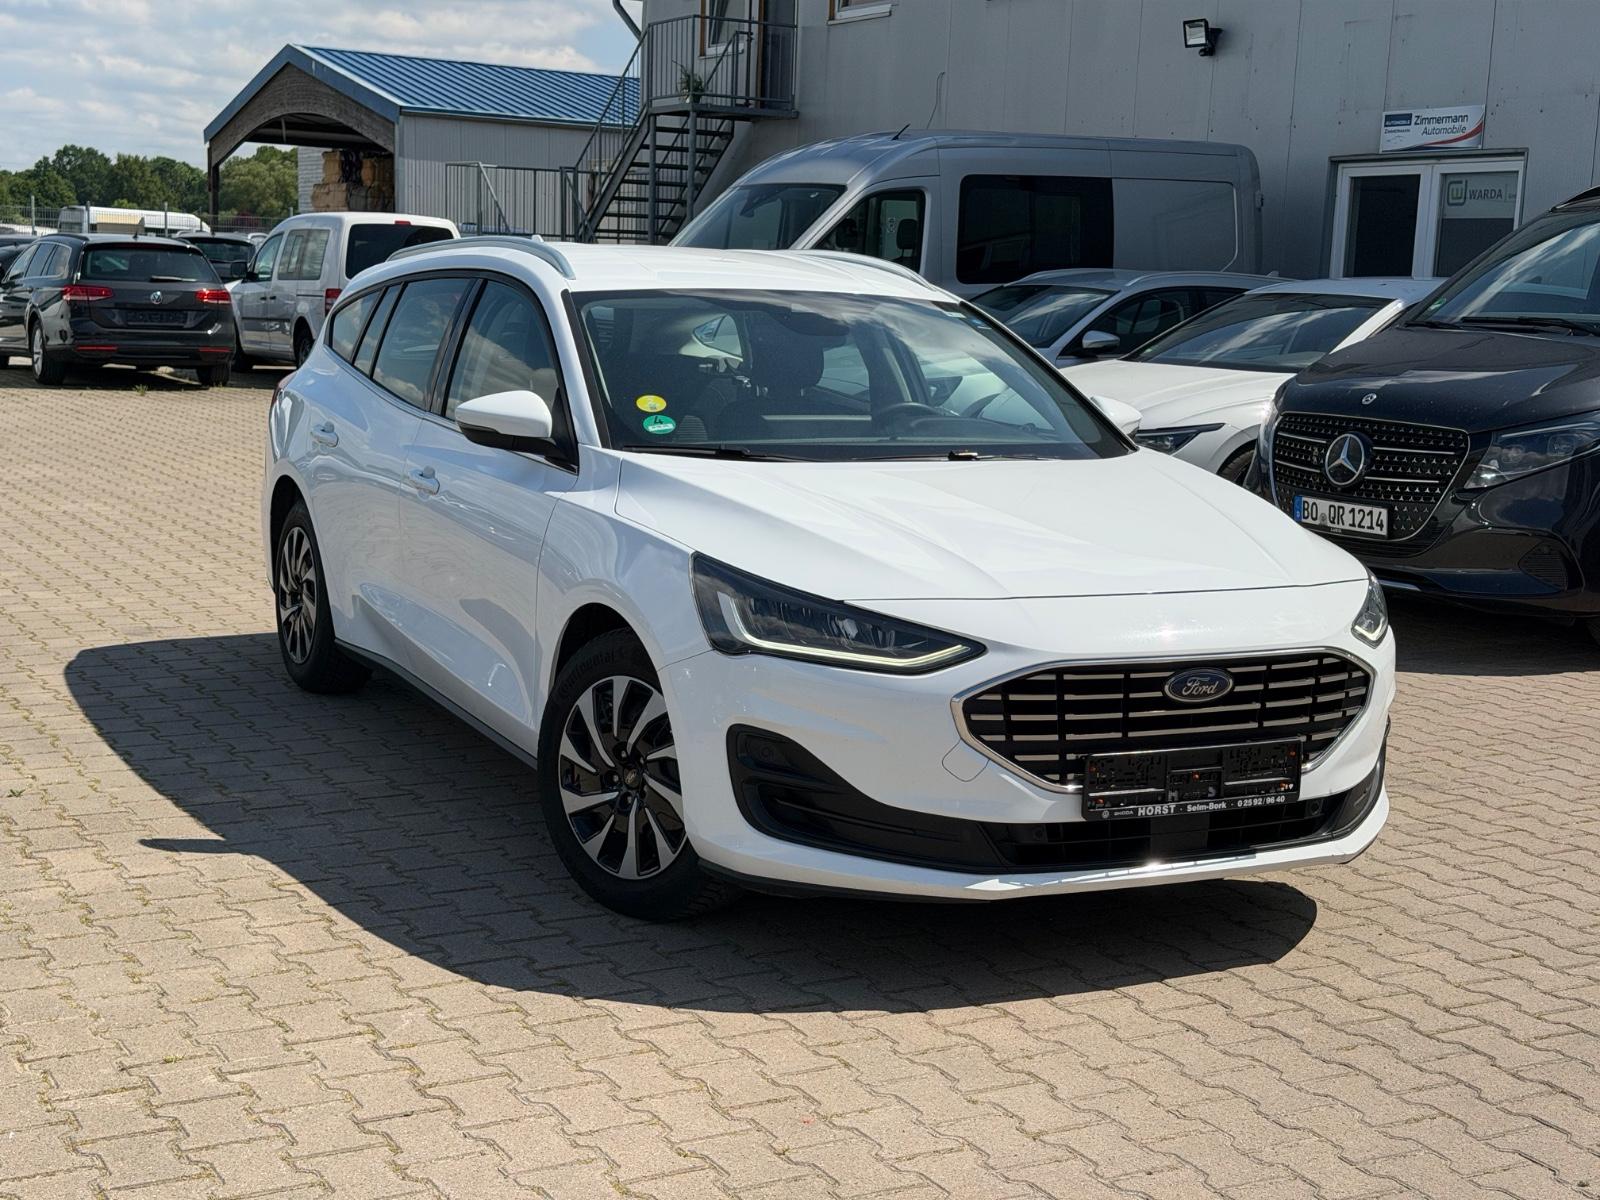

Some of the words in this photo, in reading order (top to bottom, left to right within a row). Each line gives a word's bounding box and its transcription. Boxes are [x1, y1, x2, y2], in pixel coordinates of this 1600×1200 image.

[1414, 114, 1468, 126] Zimmermann
[1421, 125, 1467, 136] Automobile
[1468, 188, 1503, 200] WARDA
[1302, 500, 1319, 522] BO
[1328, 504, 1345, 526] QR
[1348, 507, 1385, 532] 1214
[1182, 676, 1219, 696] Ford
[1137, 804, 1176, 817] HORST
[1186, 801, 1227, 812] Selm-Bork
